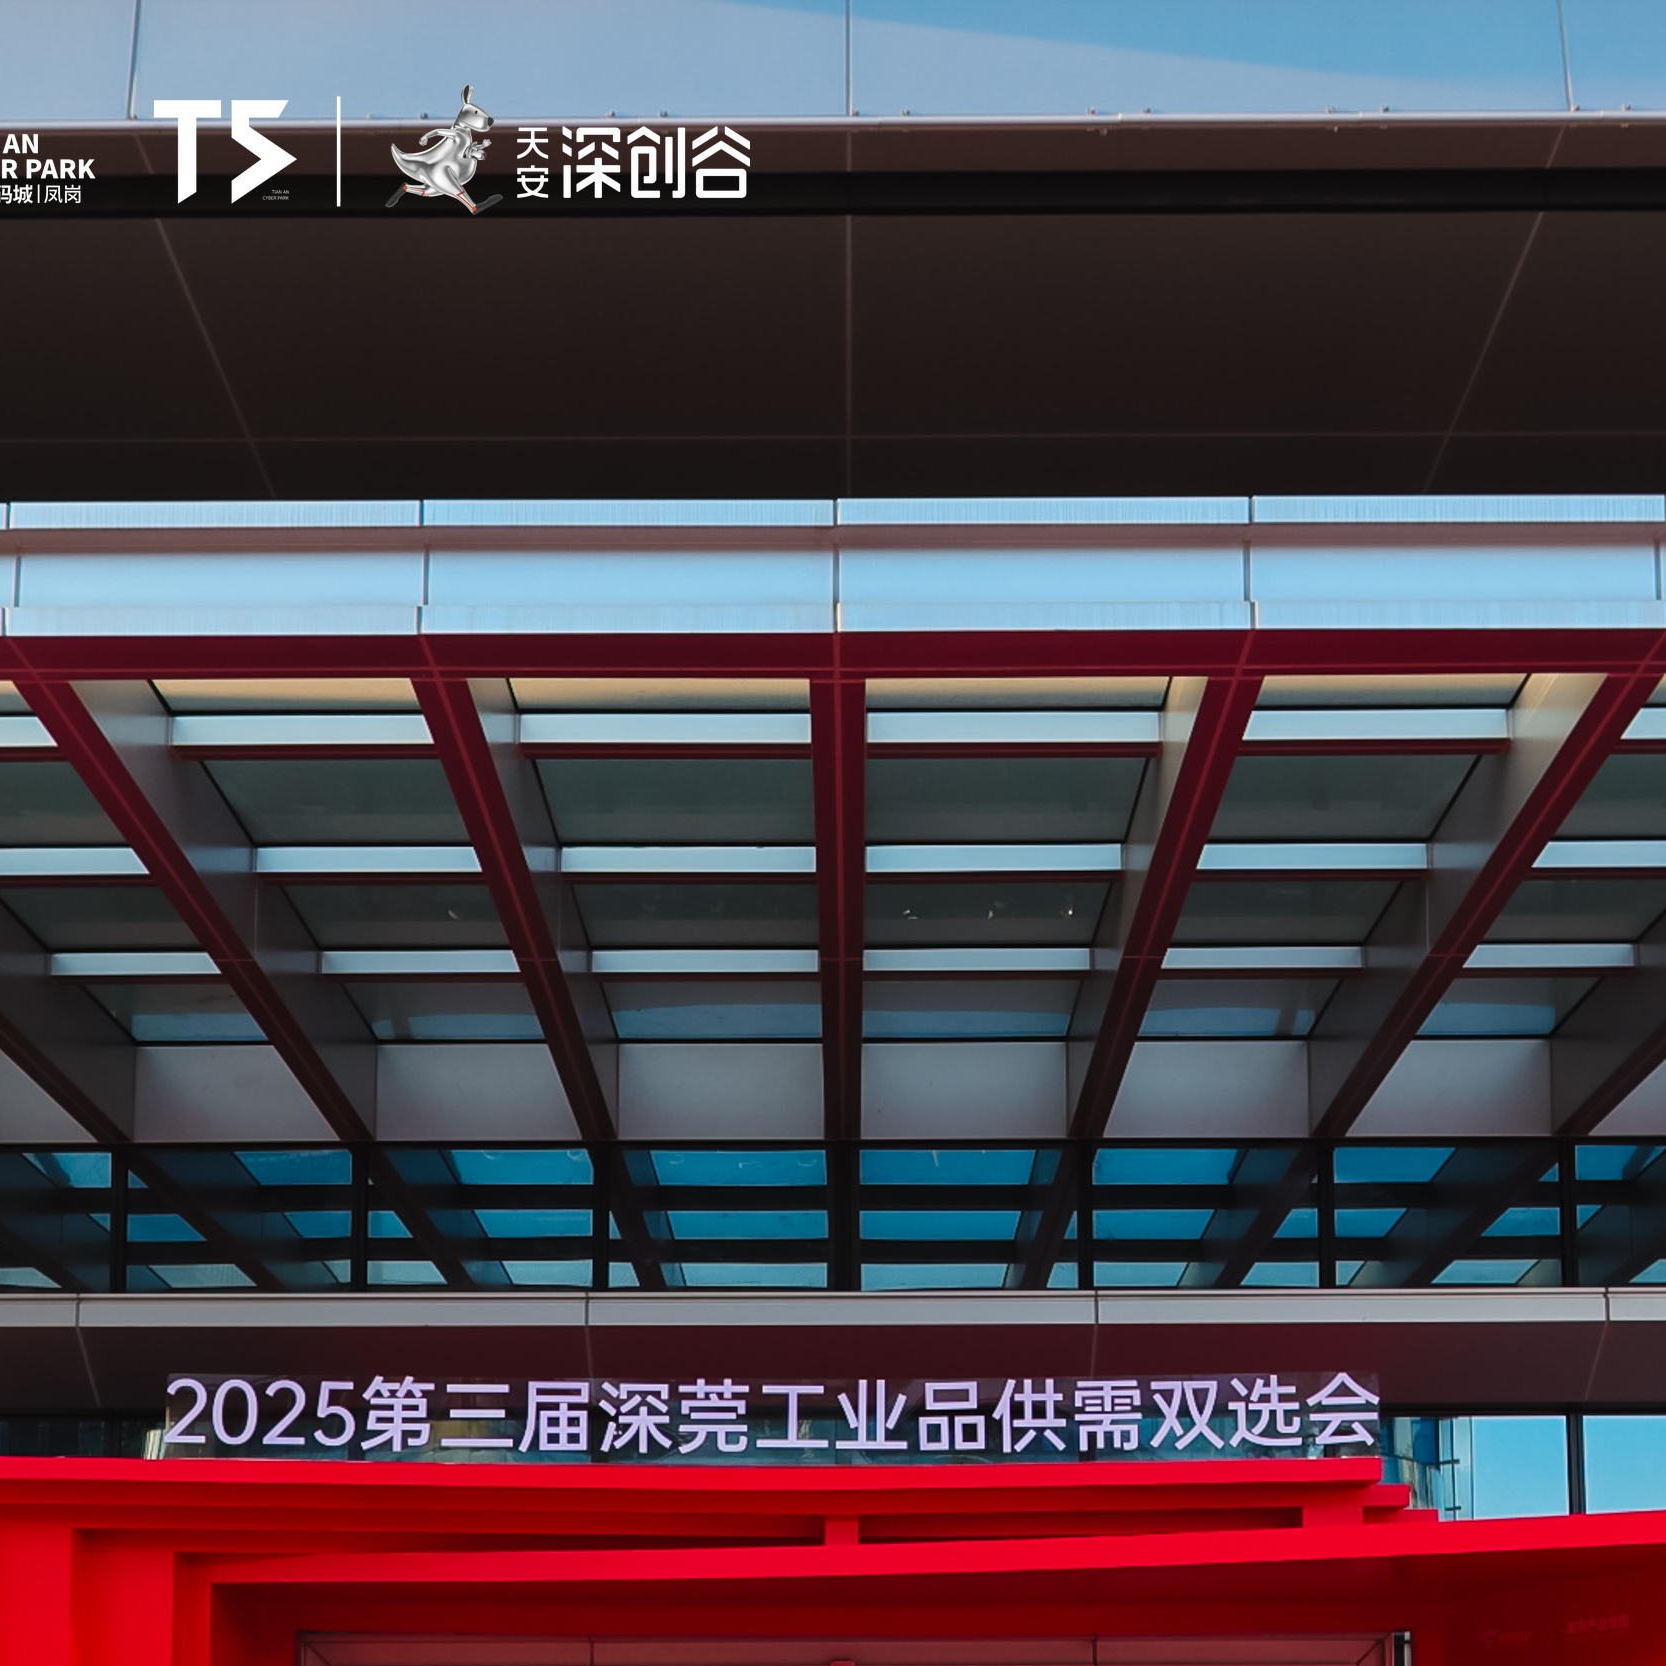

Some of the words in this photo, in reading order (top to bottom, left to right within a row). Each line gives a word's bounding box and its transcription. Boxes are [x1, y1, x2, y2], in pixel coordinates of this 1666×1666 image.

[162, 1372, 1381, 1454] 2025第三届深莞工业品供需双选会
